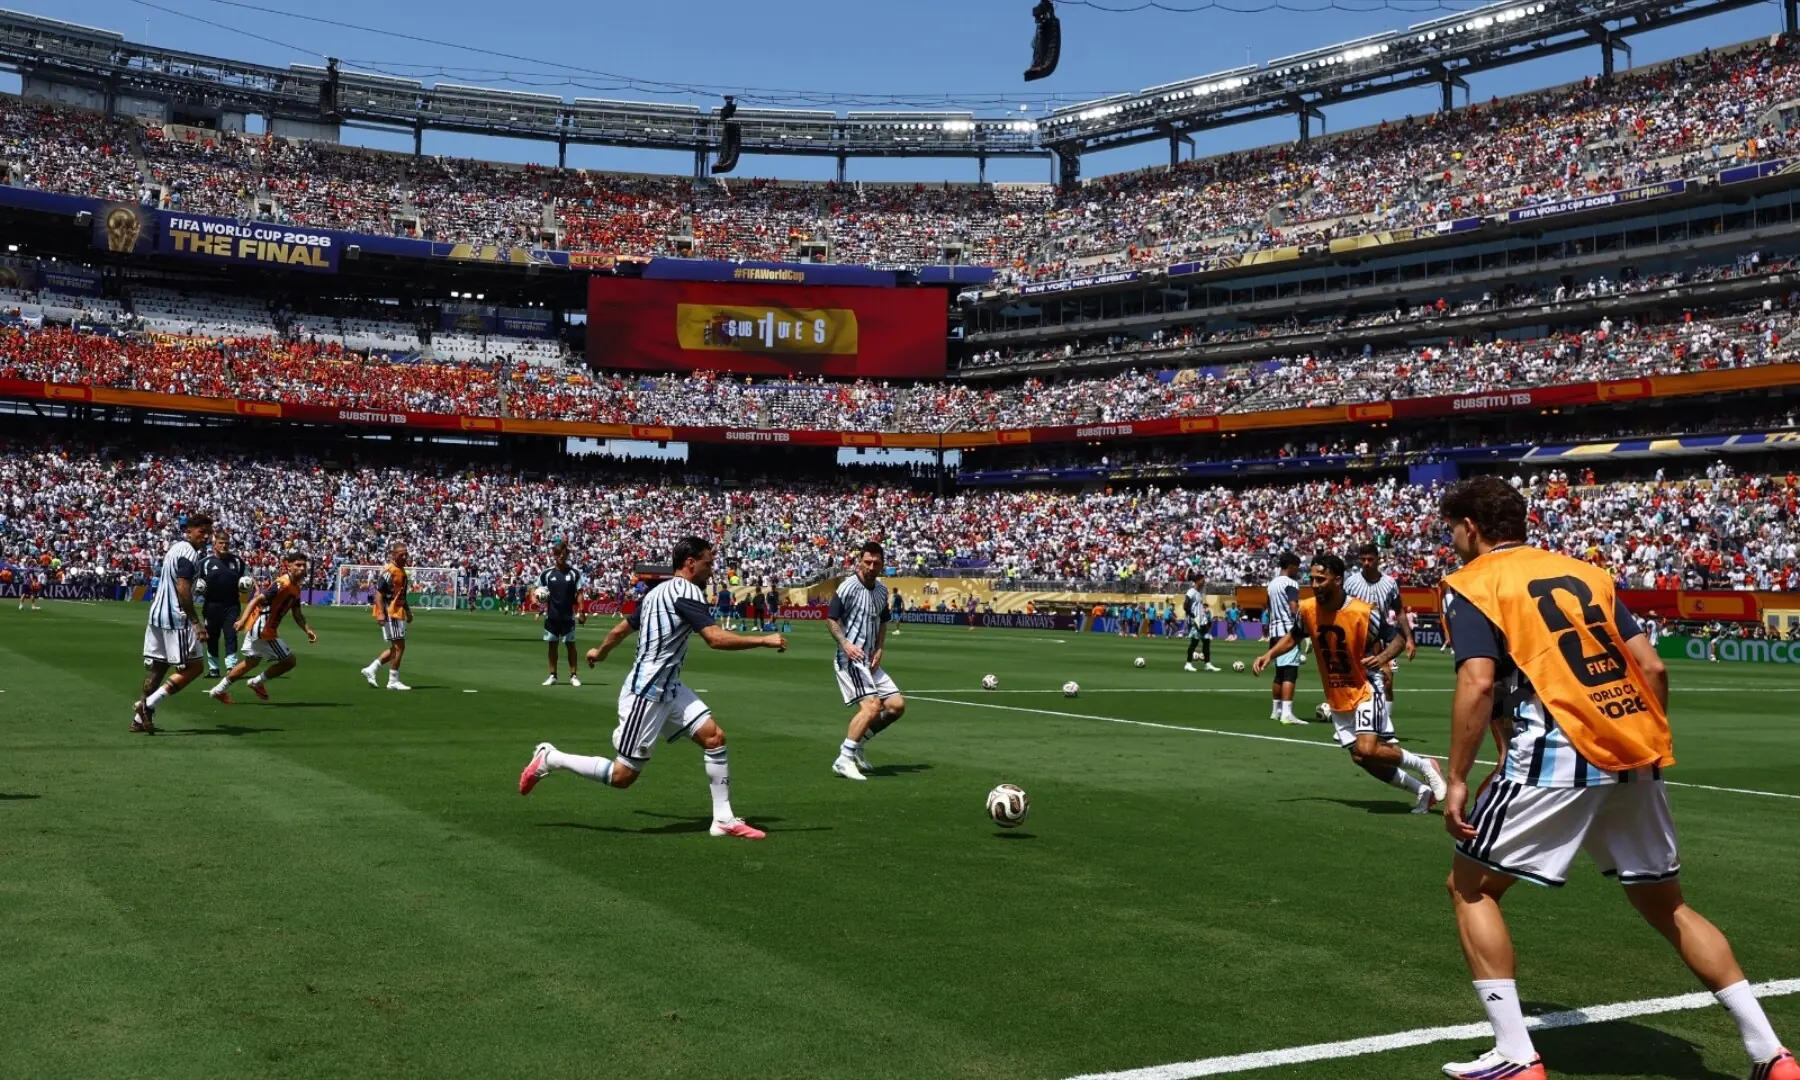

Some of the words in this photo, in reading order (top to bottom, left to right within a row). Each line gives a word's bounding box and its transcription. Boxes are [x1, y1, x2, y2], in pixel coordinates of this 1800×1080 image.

[1519, 209, 1537, 219] FIFA
[1537, 203, 1567, 216] WORLD
[1567, 200, 1585, 211] CUP
[1619, 189, 1639, 200] THE
[1641, 185, 1672, 198] FINAL
[170, 217, 200, 231] FIFA
[202, 221, 251, 238] WORLD
[254, 228, 282, 242] CUP
[283, 232, 332, 247] 2026
[169, 229, 233, 257] THE
[238, 238, 330, 268] FINAL
[734, 268, 805, 283] #FIFAWorldCup
[1025, 283, 1046, 293] NEW
[1072, 278, 1094, 287] NEW
[1095, 273, 1133, 284] JERSEY
[777, 606, 822, 620] Lenovo
[982, 614, 1012, 628] QATAR
[1015, 615, 1055, 629] AIRWAYS
[1414, 631, 1442, 645] FIFA
[1586, 657, 1620, 676] FIFA
